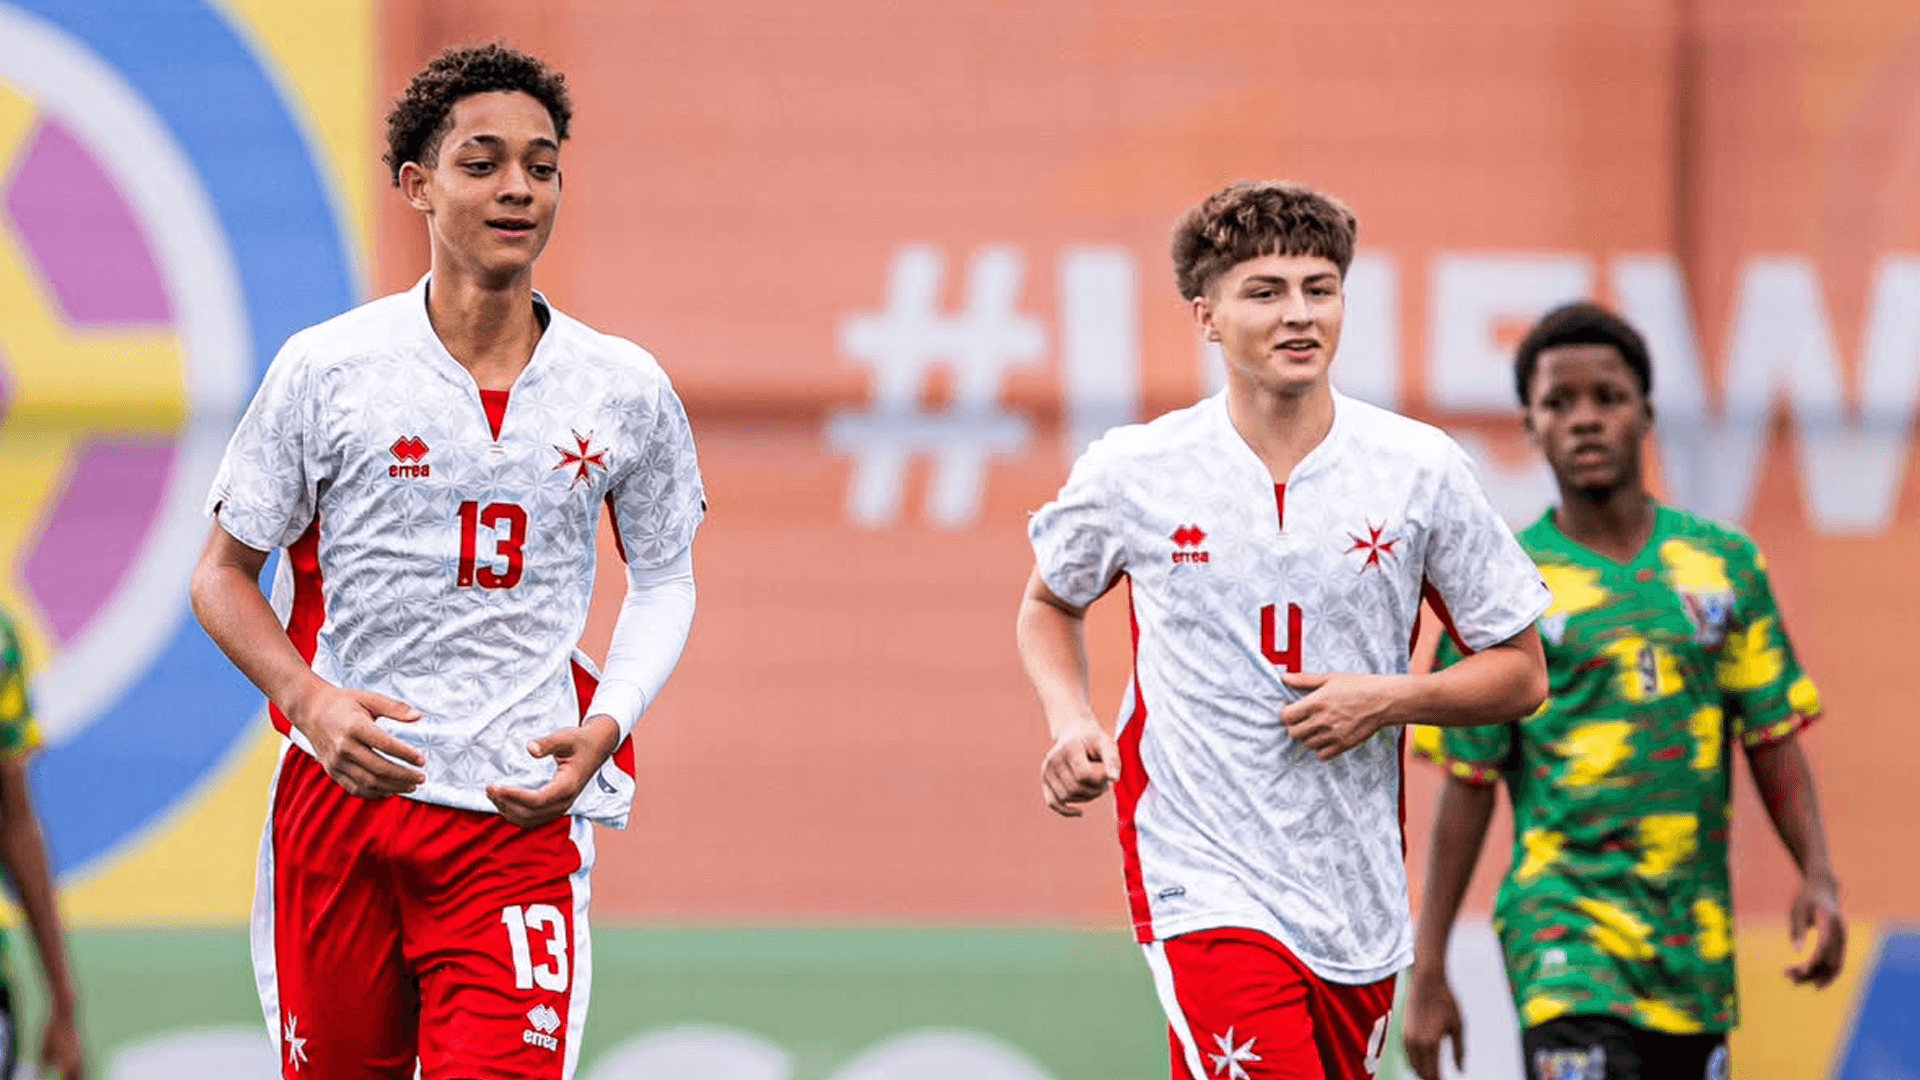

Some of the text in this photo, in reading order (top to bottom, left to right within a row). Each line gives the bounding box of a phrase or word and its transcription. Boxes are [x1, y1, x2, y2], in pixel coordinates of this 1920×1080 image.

[389, 464, 430, 478] errea
[457, 500, 527, 589] 13
[1260, 602, 1302, 673] 4
[501, 904, 569, 993] 13
